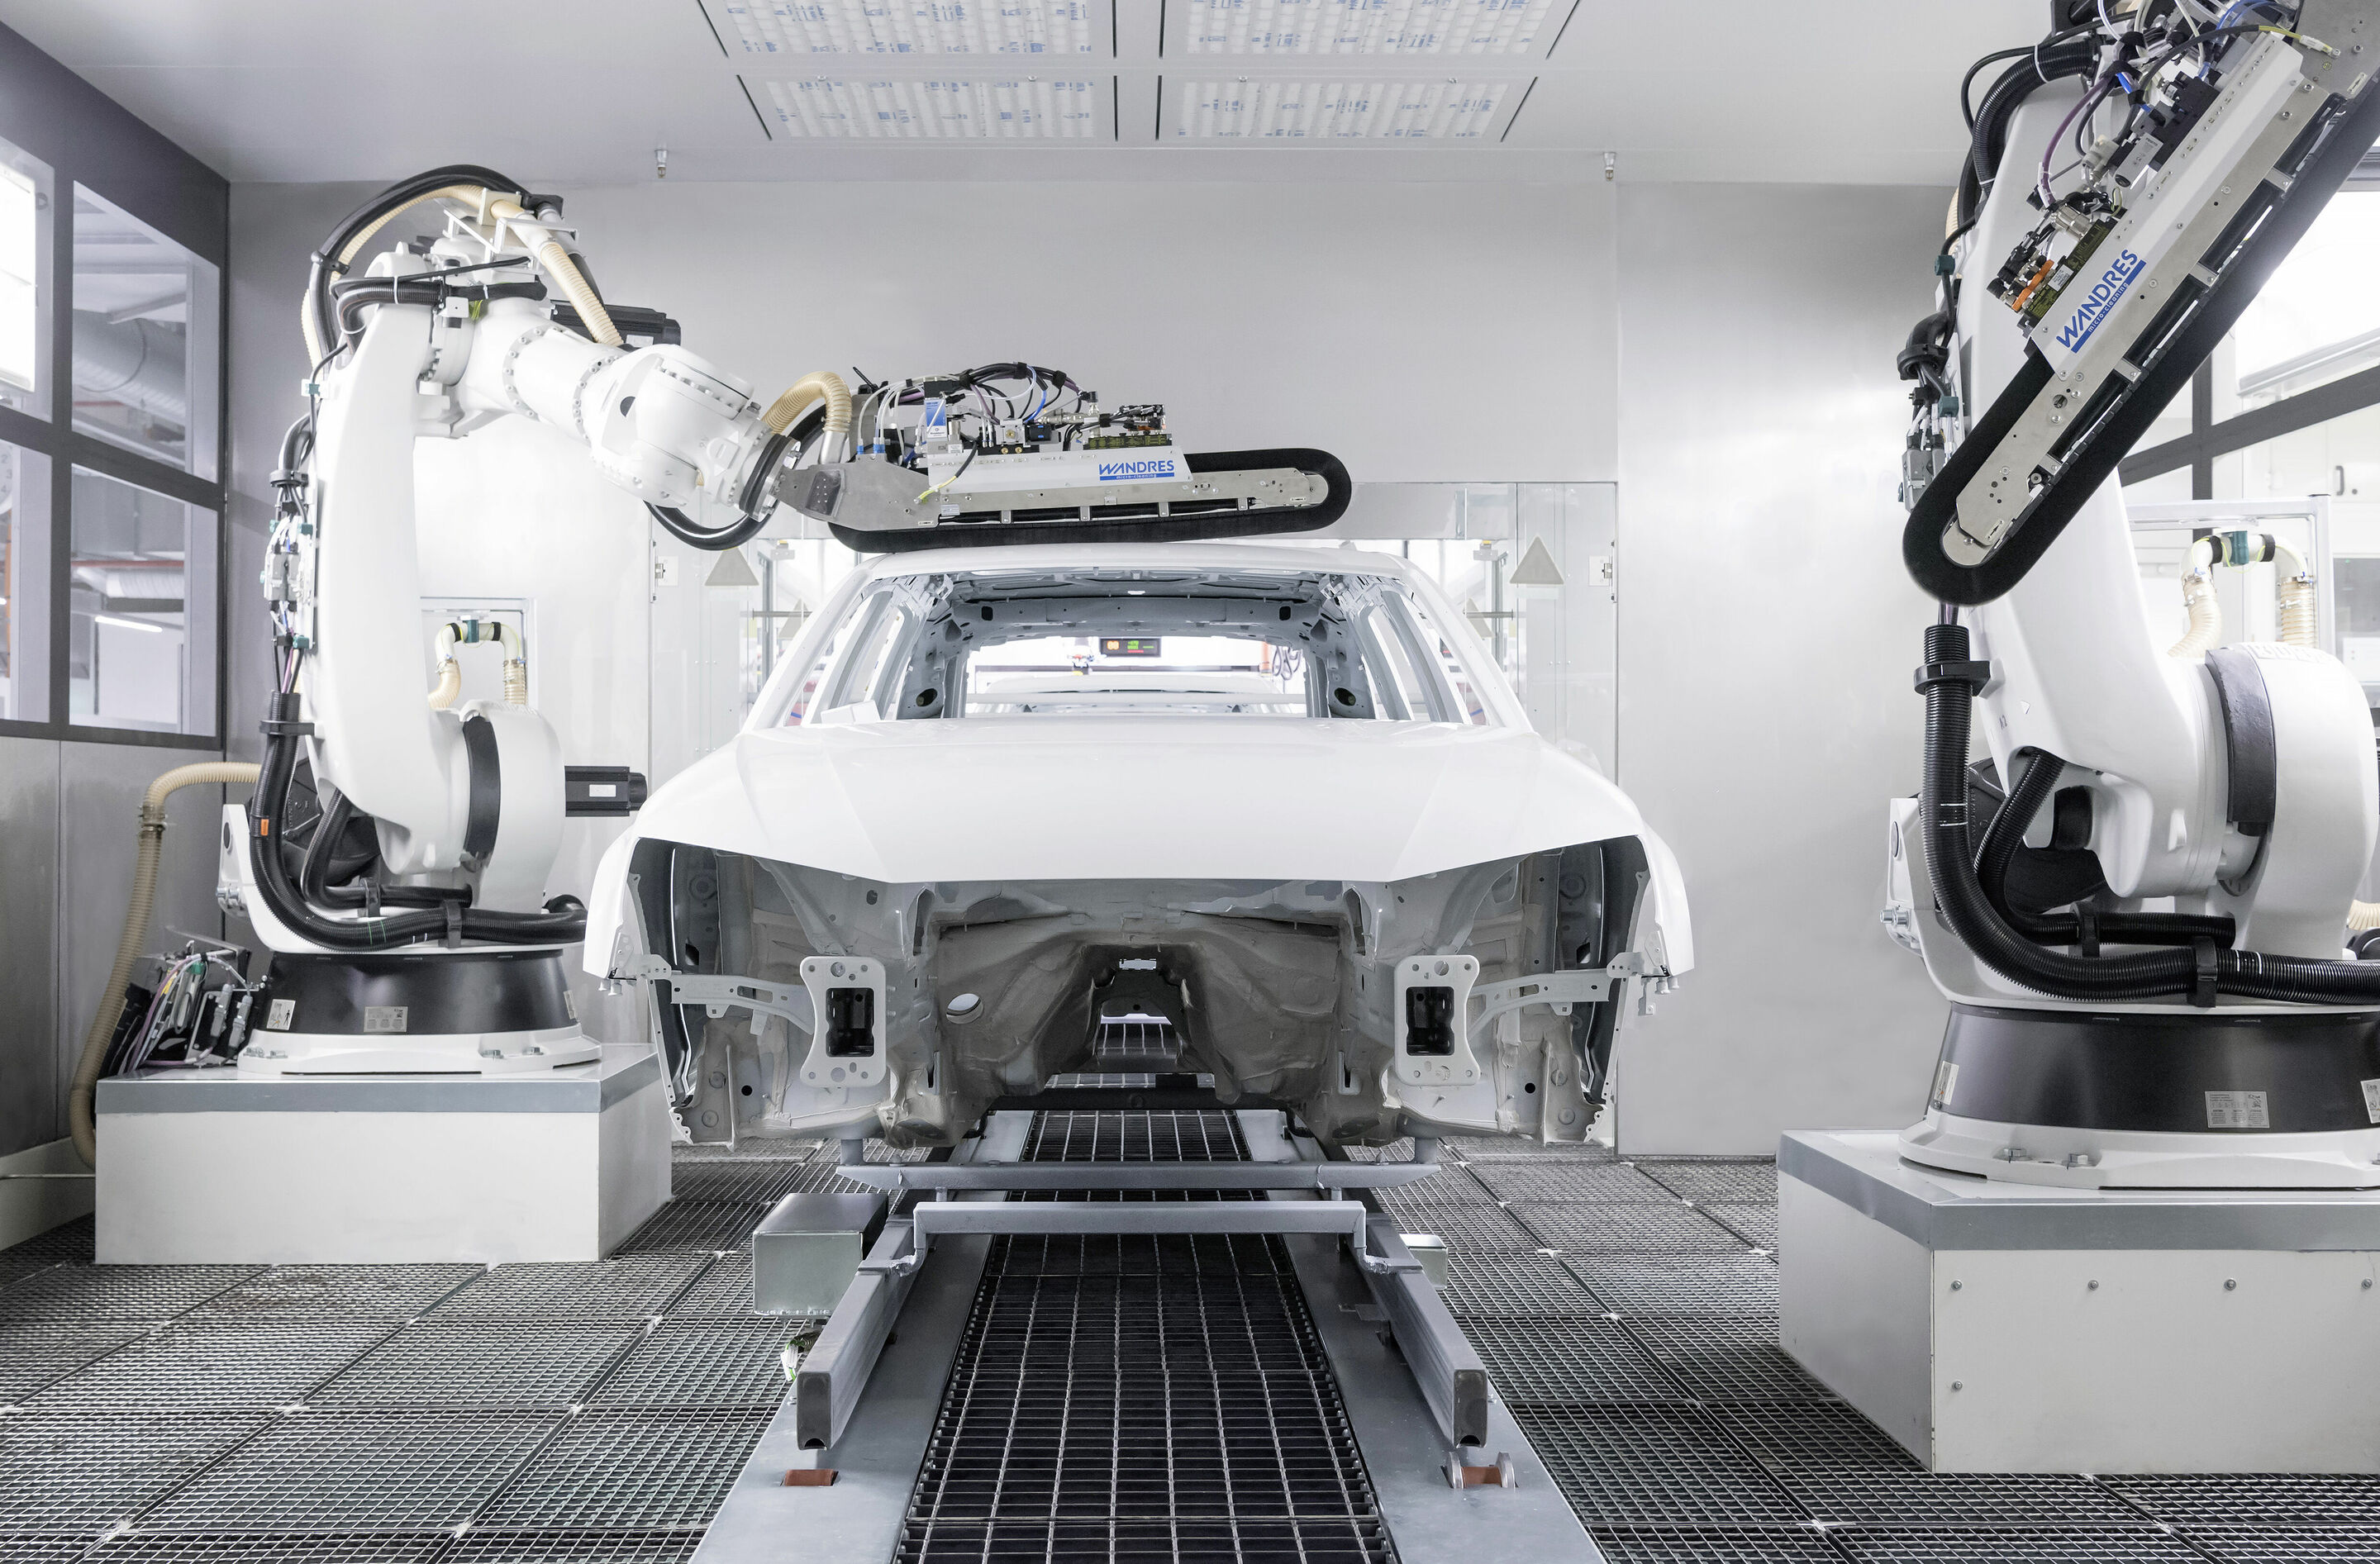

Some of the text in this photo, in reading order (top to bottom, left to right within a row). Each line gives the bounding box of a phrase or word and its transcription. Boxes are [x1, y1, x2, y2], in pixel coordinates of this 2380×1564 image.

[2055, 249, 2138, 348] WANDRES
[2087, 283, 2130, 333] micro-cleaning
[1099, 459, 1174, 475] WANDRES
